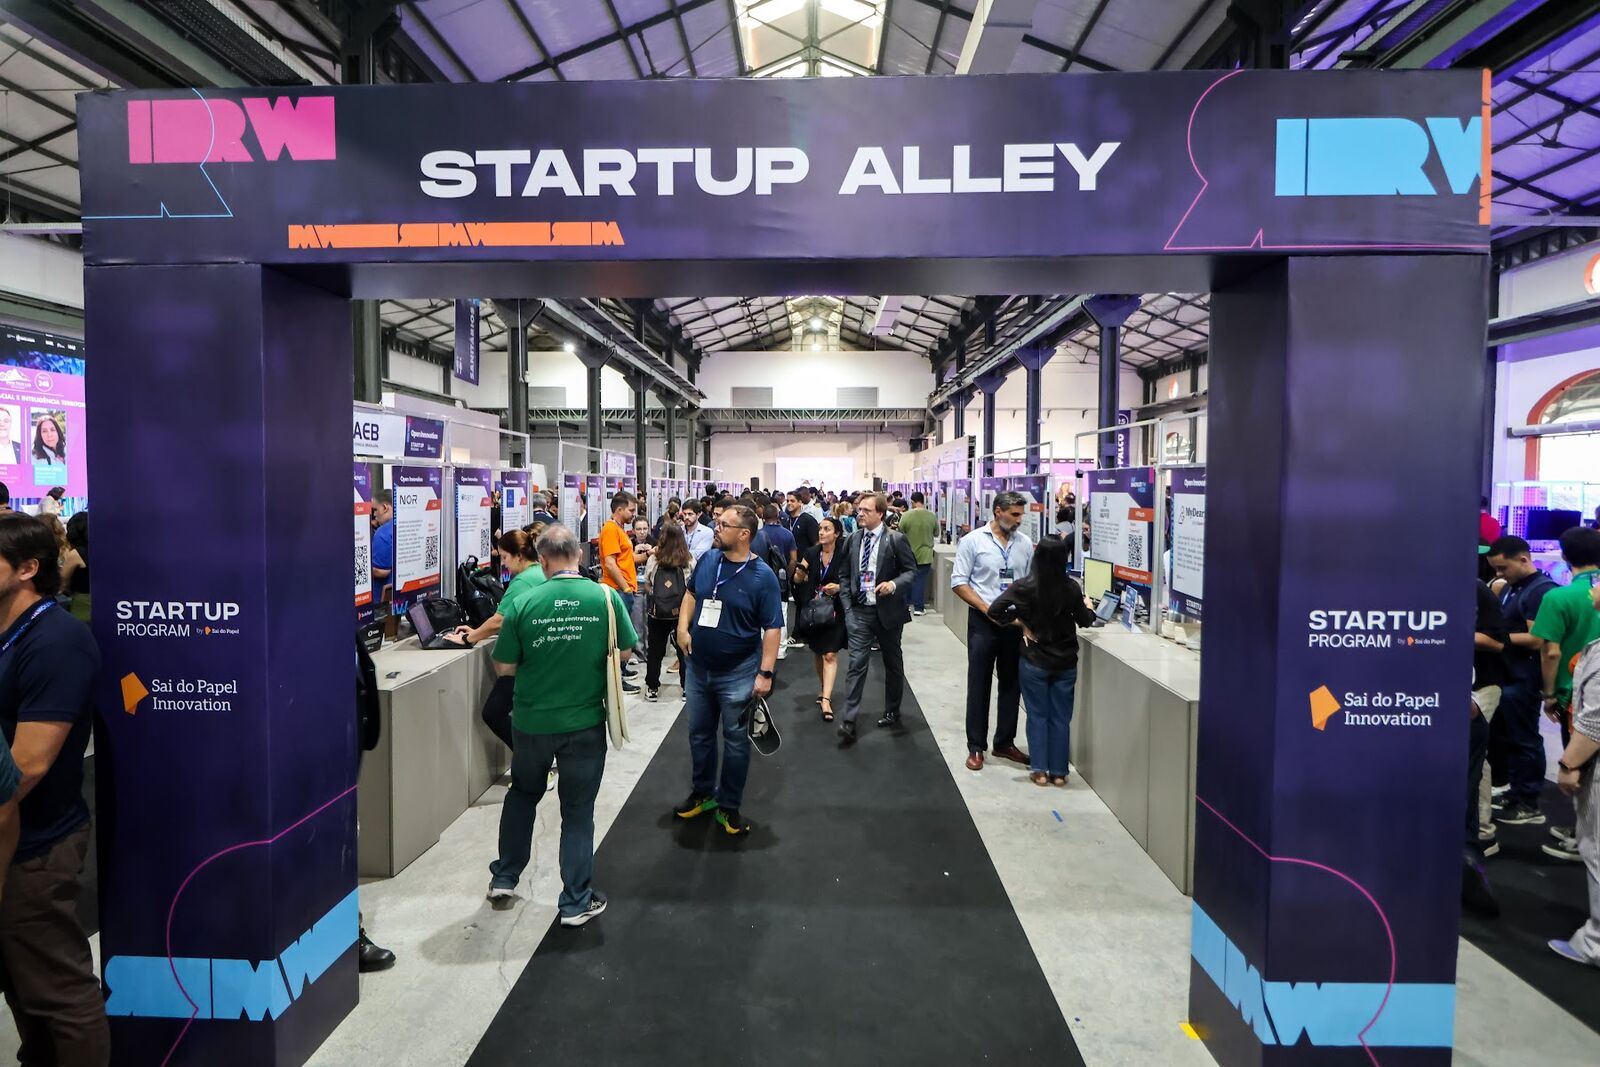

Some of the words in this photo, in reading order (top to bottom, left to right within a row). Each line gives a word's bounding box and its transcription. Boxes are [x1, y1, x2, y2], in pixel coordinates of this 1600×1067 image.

[420, 147, 810, 199] STARTUP
[838, 142, 1122, 195] ALLEY
[353, 421, 380, 441] AEB
[1117, 433, 1125, 465] PALCO
[116, 600, 240, 621] STARTUP
[1308, 610, 1448, 630] STARTUP
[117, 623, 190, 637] PROGRAM
[196, 626, 204, 636] by
[1308, 634, 1391, 648] PROGRAM
[151, 679, 173, 693] Sai
[176, 679, 195, 693] do
[197, 679, 238, 696] Papel
[152, 696, 232, 711] Innovation
[1344, 692, 1368, 707] Sai
[1371, 692, 1392, 707] do
[1394, 692, 1440, 709] Papel
[1344, 711, 1432, 726] Innovation
